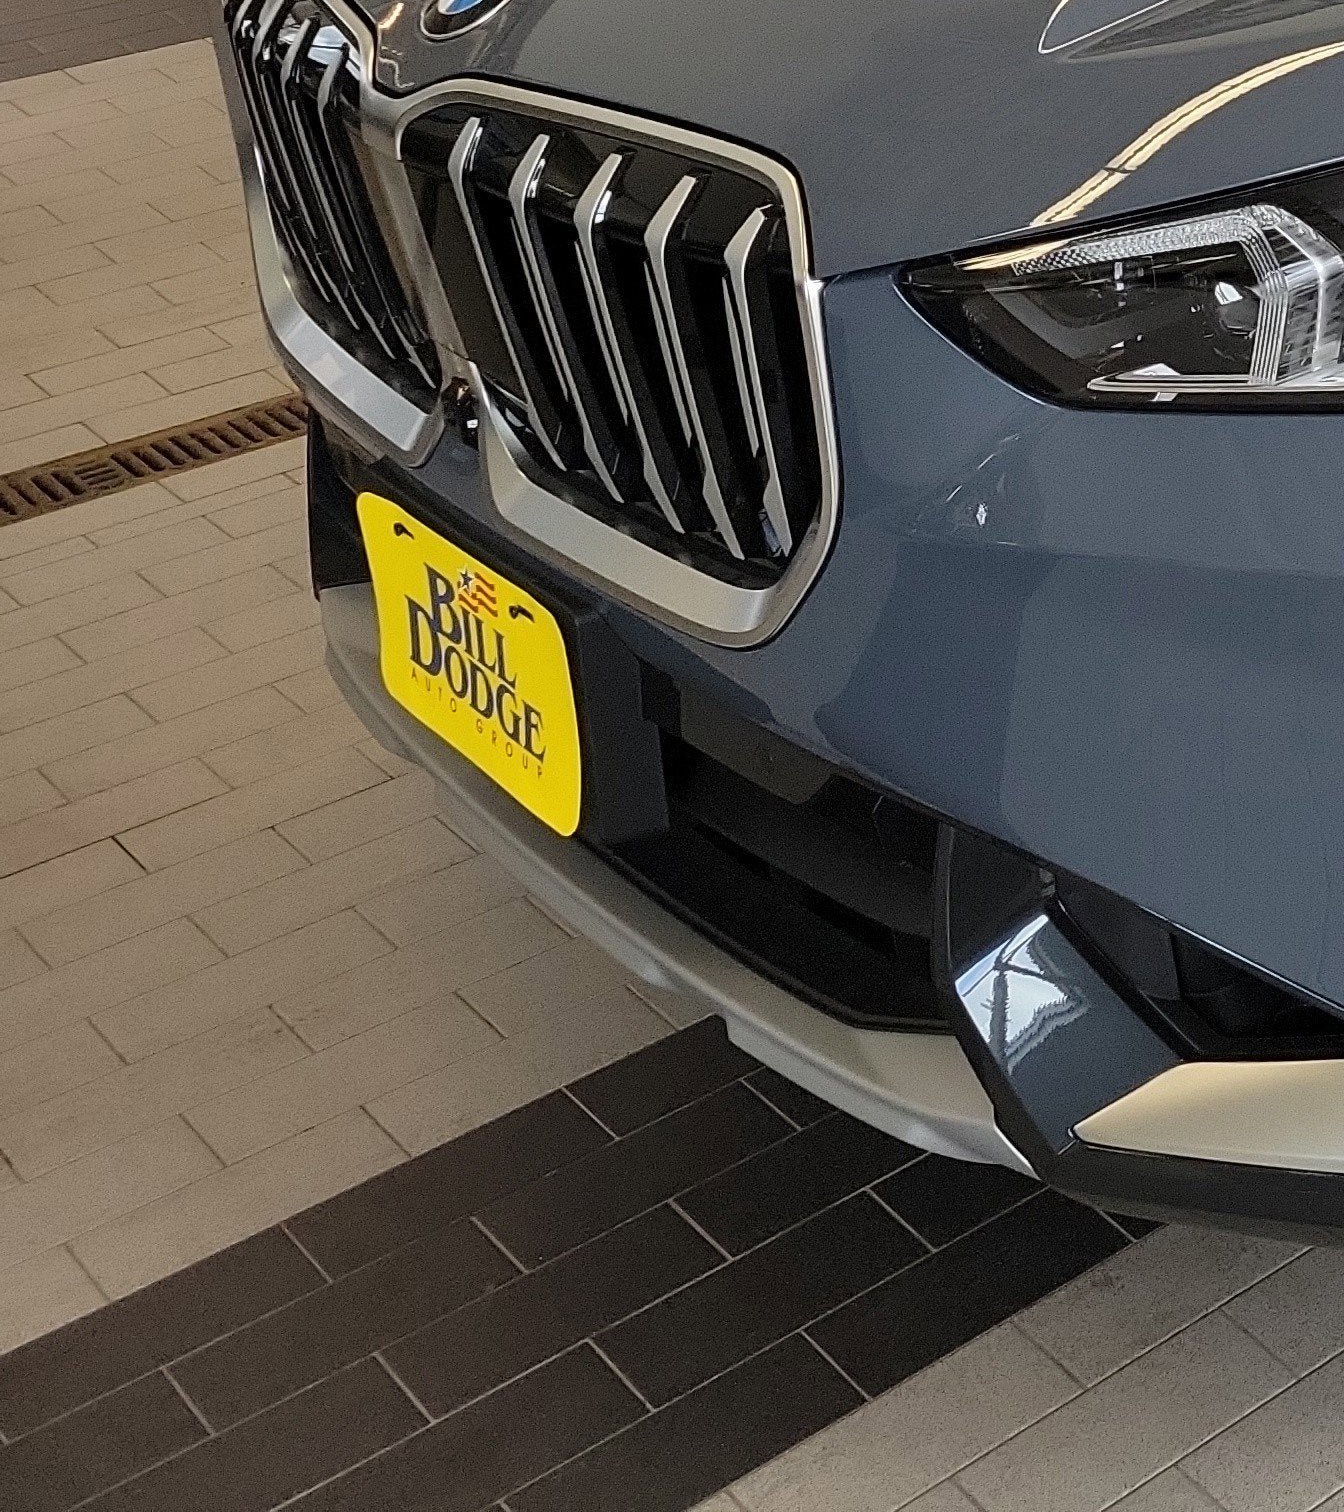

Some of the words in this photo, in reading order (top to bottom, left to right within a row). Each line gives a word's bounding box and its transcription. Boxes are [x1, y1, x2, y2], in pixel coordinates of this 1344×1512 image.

[405, 594, 548, 763] DODGE
[423, 561, 518, 688] BILL
[410, 666, 459, 715] AUTO
[474, 720, 545, 780] GROUP
